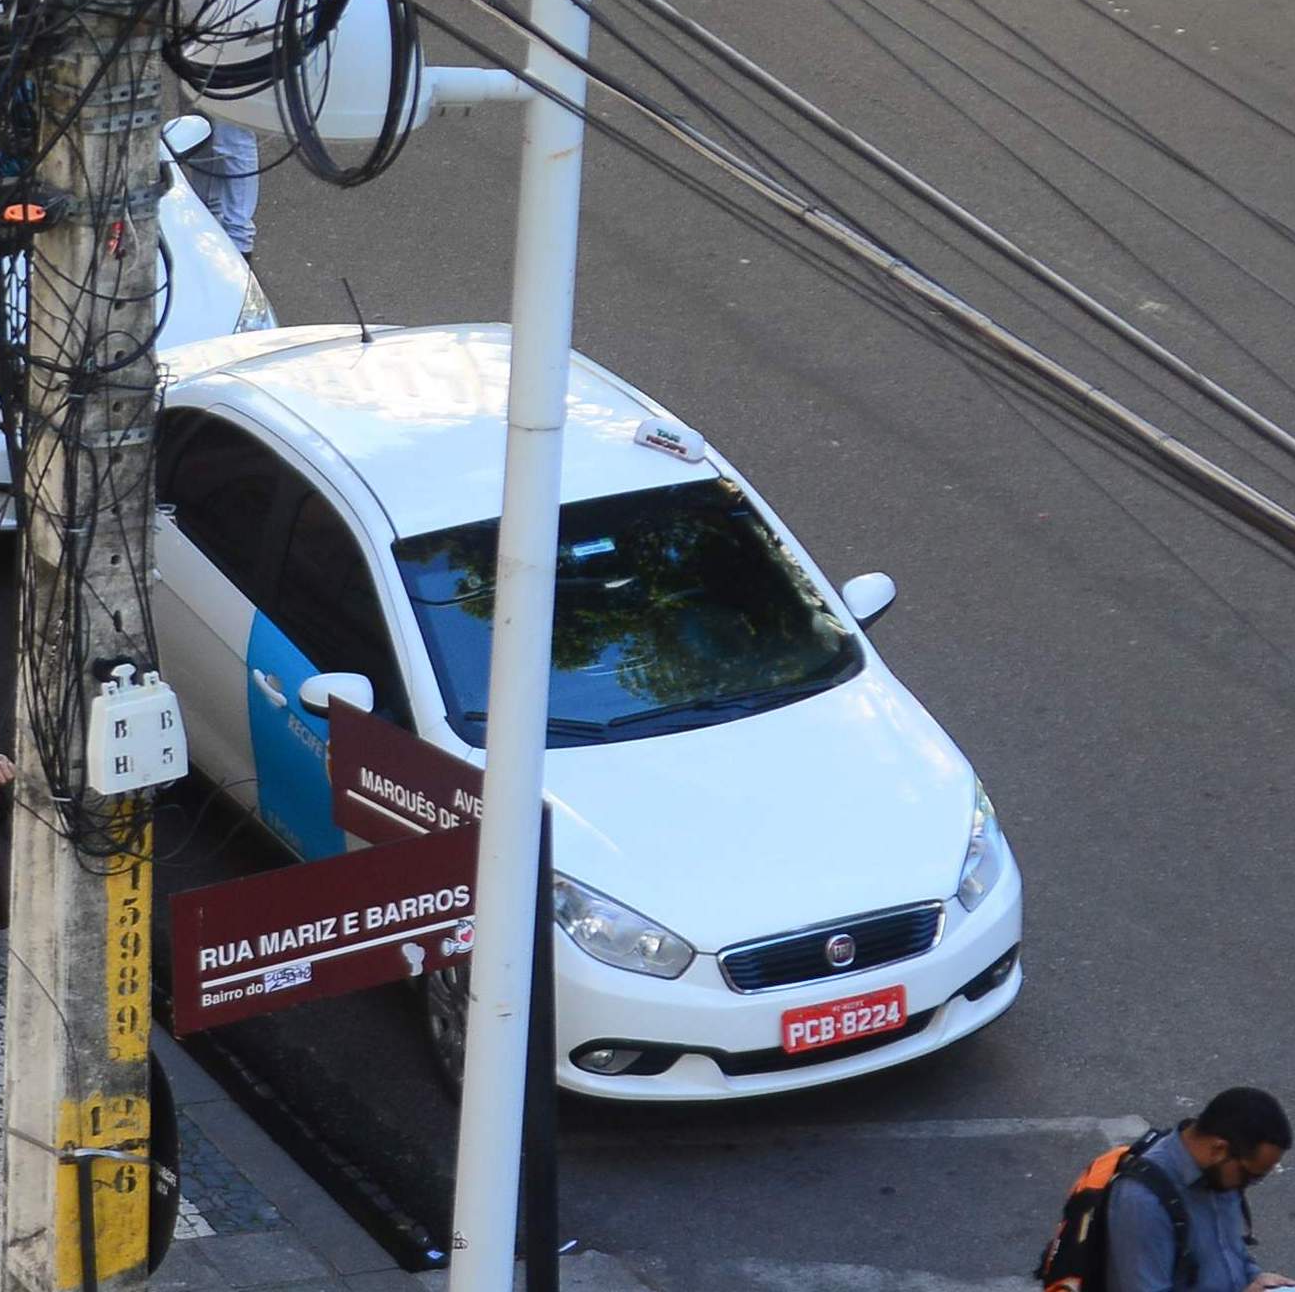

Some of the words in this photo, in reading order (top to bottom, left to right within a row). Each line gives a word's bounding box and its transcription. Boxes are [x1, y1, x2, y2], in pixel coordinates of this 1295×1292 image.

[162, 747, 174, 764] 5
[360, 766, 437, 824] MARQUÊS
[200, 941, 253, 972] RUA
[259, 917, 337, 958] MARIZ
[343, 912, 360, 936] E
[366, 884, 471, 930] BARROS
[201, 988, 244, 1008] Bairro
[246, 981, 264, 998] do
